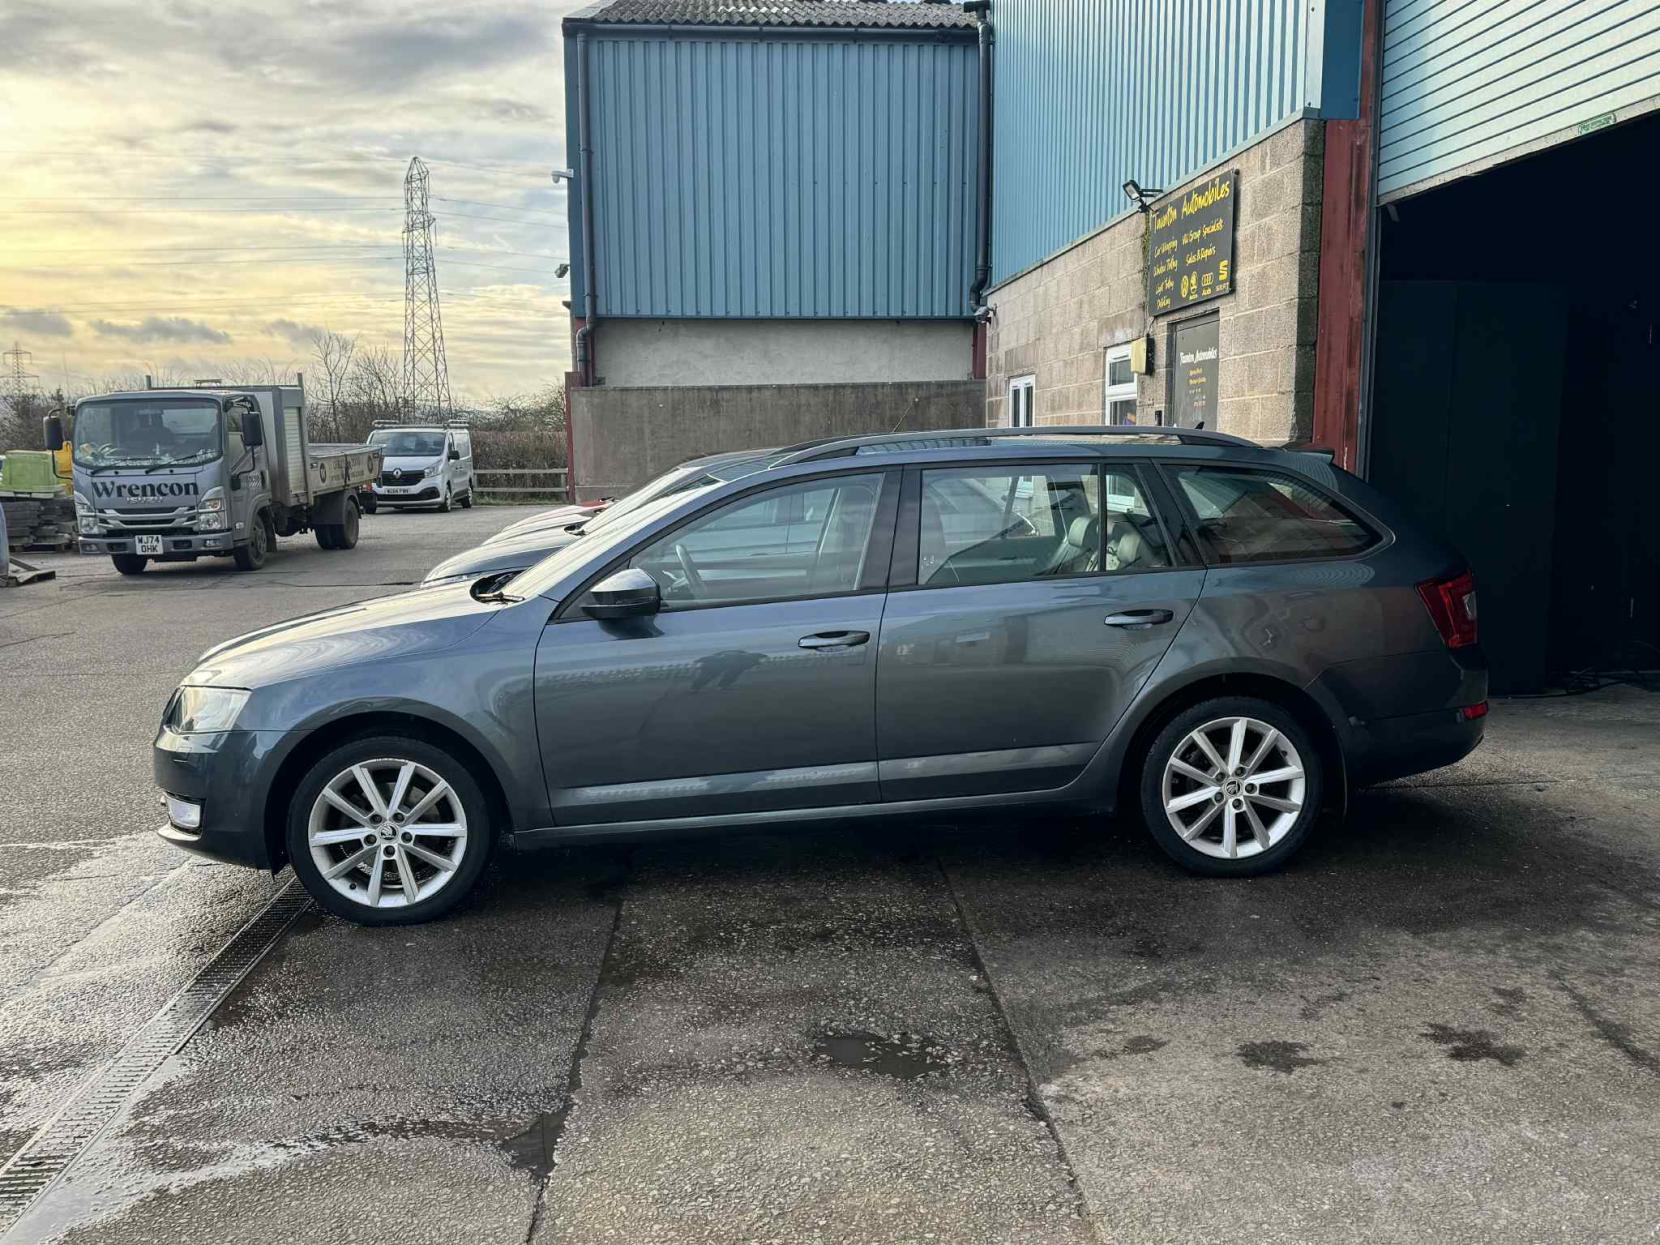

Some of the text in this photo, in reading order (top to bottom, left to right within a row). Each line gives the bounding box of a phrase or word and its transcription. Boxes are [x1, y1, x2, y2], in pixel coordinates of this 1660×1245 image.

[1181, 178, 1230, 219] Automobiles
[91, 481, 199, 498] Wrencon
[136, 535, 160, 544] WJ74
